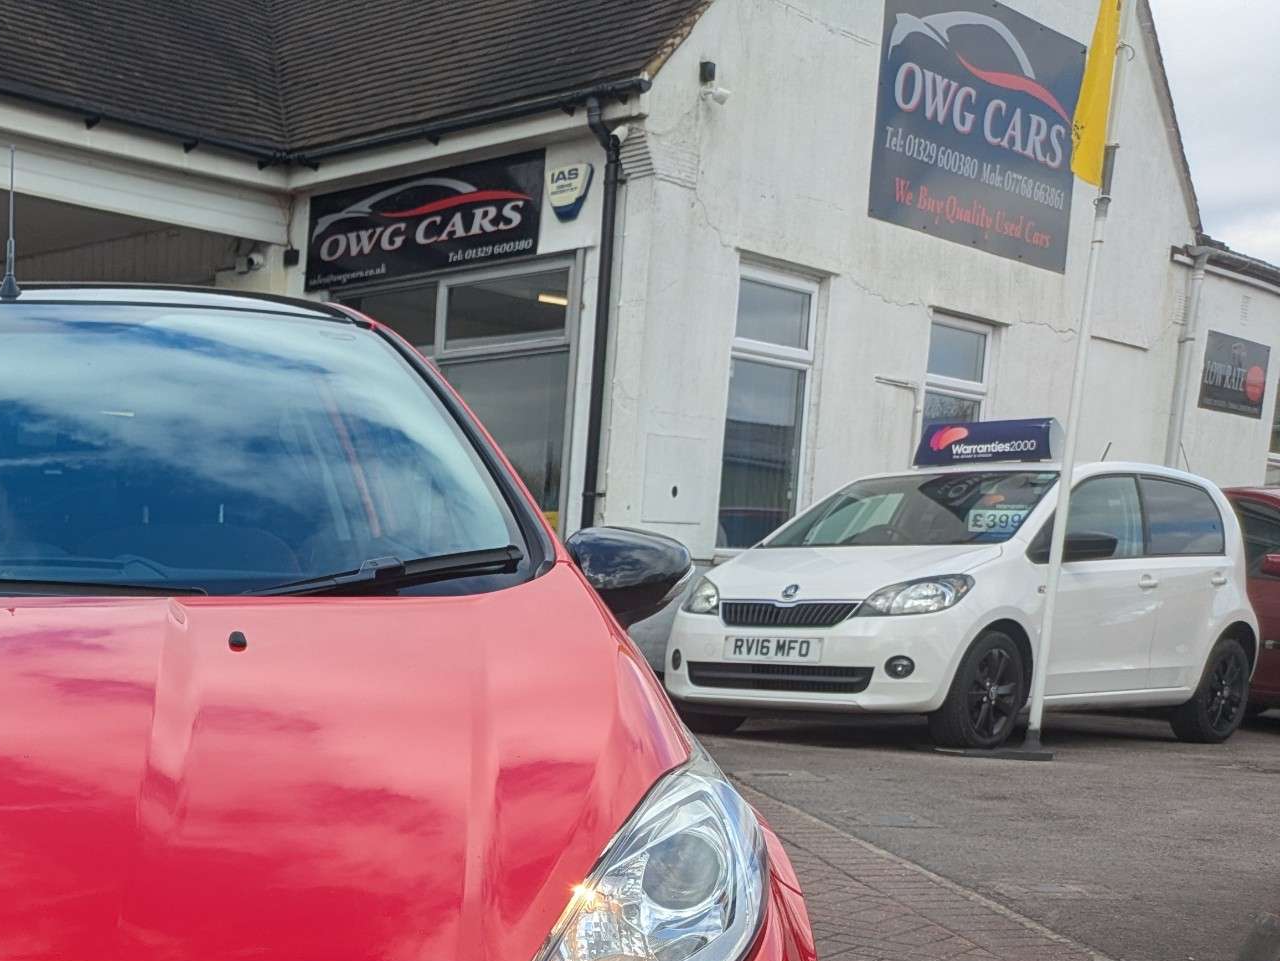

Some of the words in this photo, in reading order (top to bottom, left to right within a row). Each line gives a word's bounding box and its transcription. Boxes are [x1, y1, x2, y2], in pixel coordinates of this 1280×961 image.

[894, 62, 977, 135] OWG
[983, 99, 1066, 169] CARS
[550, 168, 579, 184] IAS
[884, 126, 904, 151] Tel:
[905, 134, 937, 165] 01329
[937, 150, 978, 179] 600380
[980, 163, 1002, 188] Mob:
[320, 222, 406, 262] OWG
[415, 200, 524, 245] CARS
[894, 177, 913, 206] We
[917, 184, 944, 225] Buy
[944, 195, 993, 240] Quality
[994, 208, 1023, 239] Used
[1024, 221, 1052, 249] Cars
[448, 250, 463, 262] Tel:
[951, 440, 1036, 454] Warranties2000
[733, 638, 771, 656] RV16
[775, 639, 810, 657] MFO
